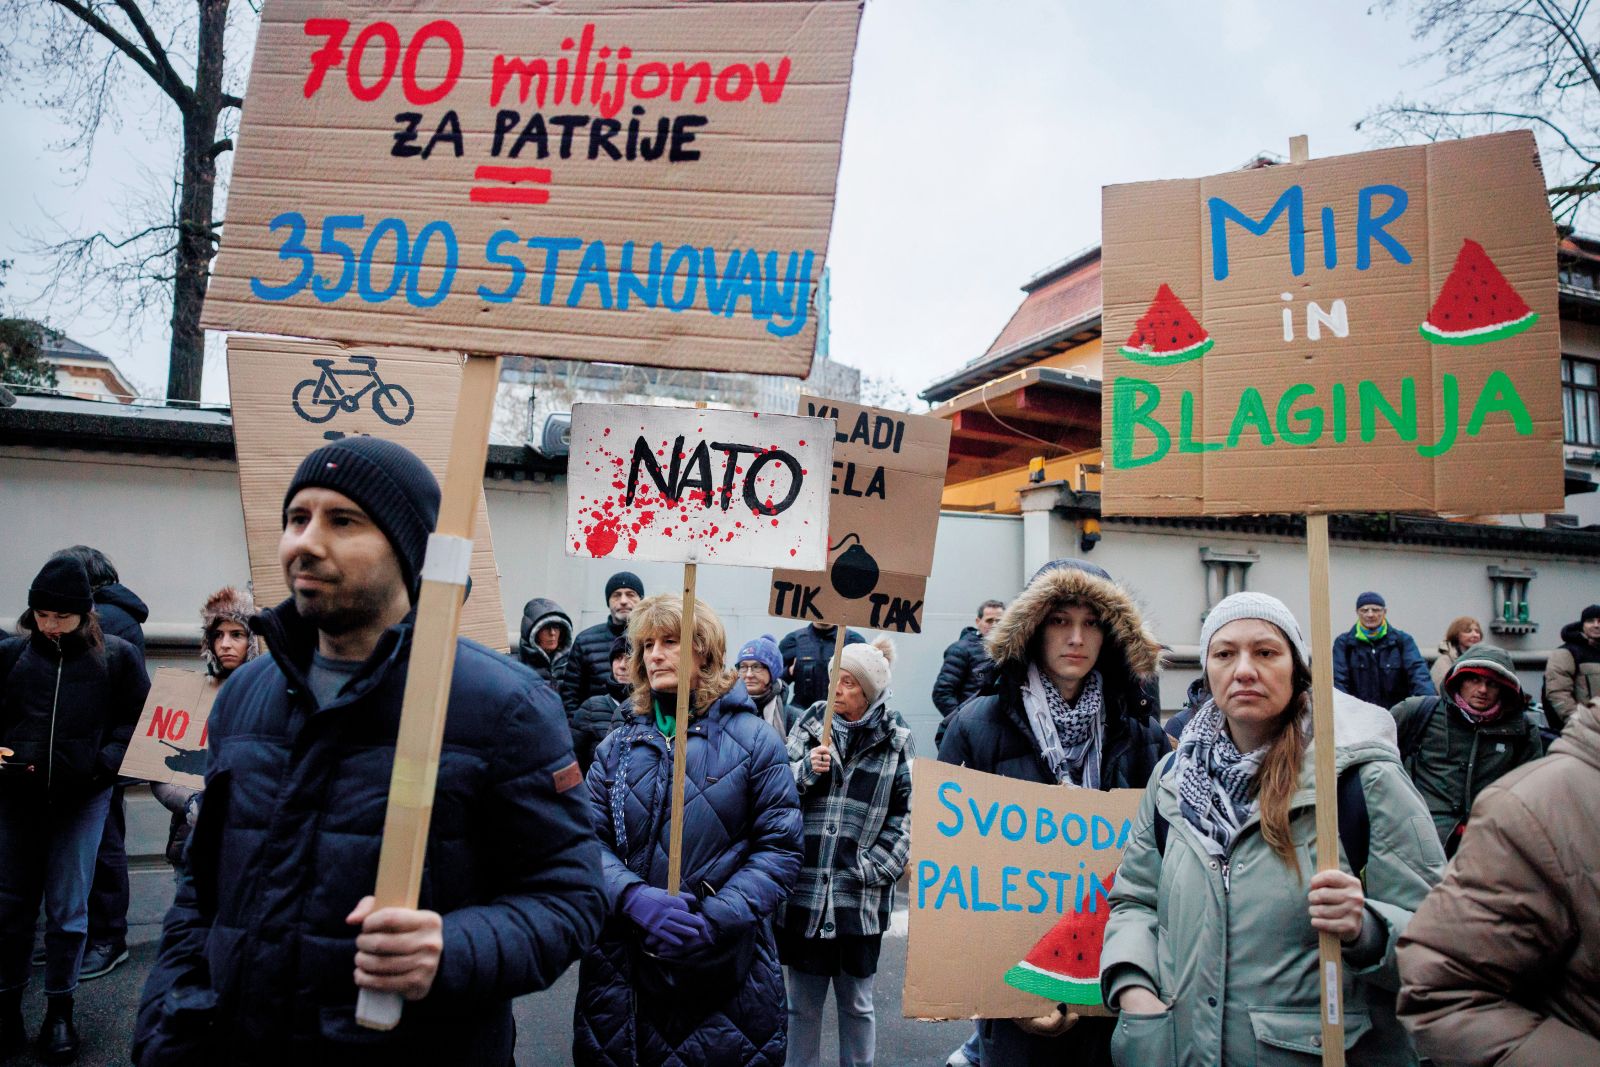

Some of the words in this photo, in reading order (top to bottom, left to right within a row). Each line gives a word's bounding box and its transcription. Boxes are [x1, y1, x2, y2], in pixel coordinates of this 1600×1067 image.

[303, 19, 464, 105] 700
[490, 24, 792, 118] milijonov
[391, 110, 464, 159] ZA
[250, 212, 458, 308] 3500
[477, 229, 815, 338] STANOVANJ
[1207, 184, 1413, 281] MIR
[1111, 370, 1534, 470] BLAGINJA
[625, 434, 804, 516] NATO
[773, 581, 824, 620] TIK
[869, 593, 924, 634] TAK
[146, 705, 190, 742] NO
